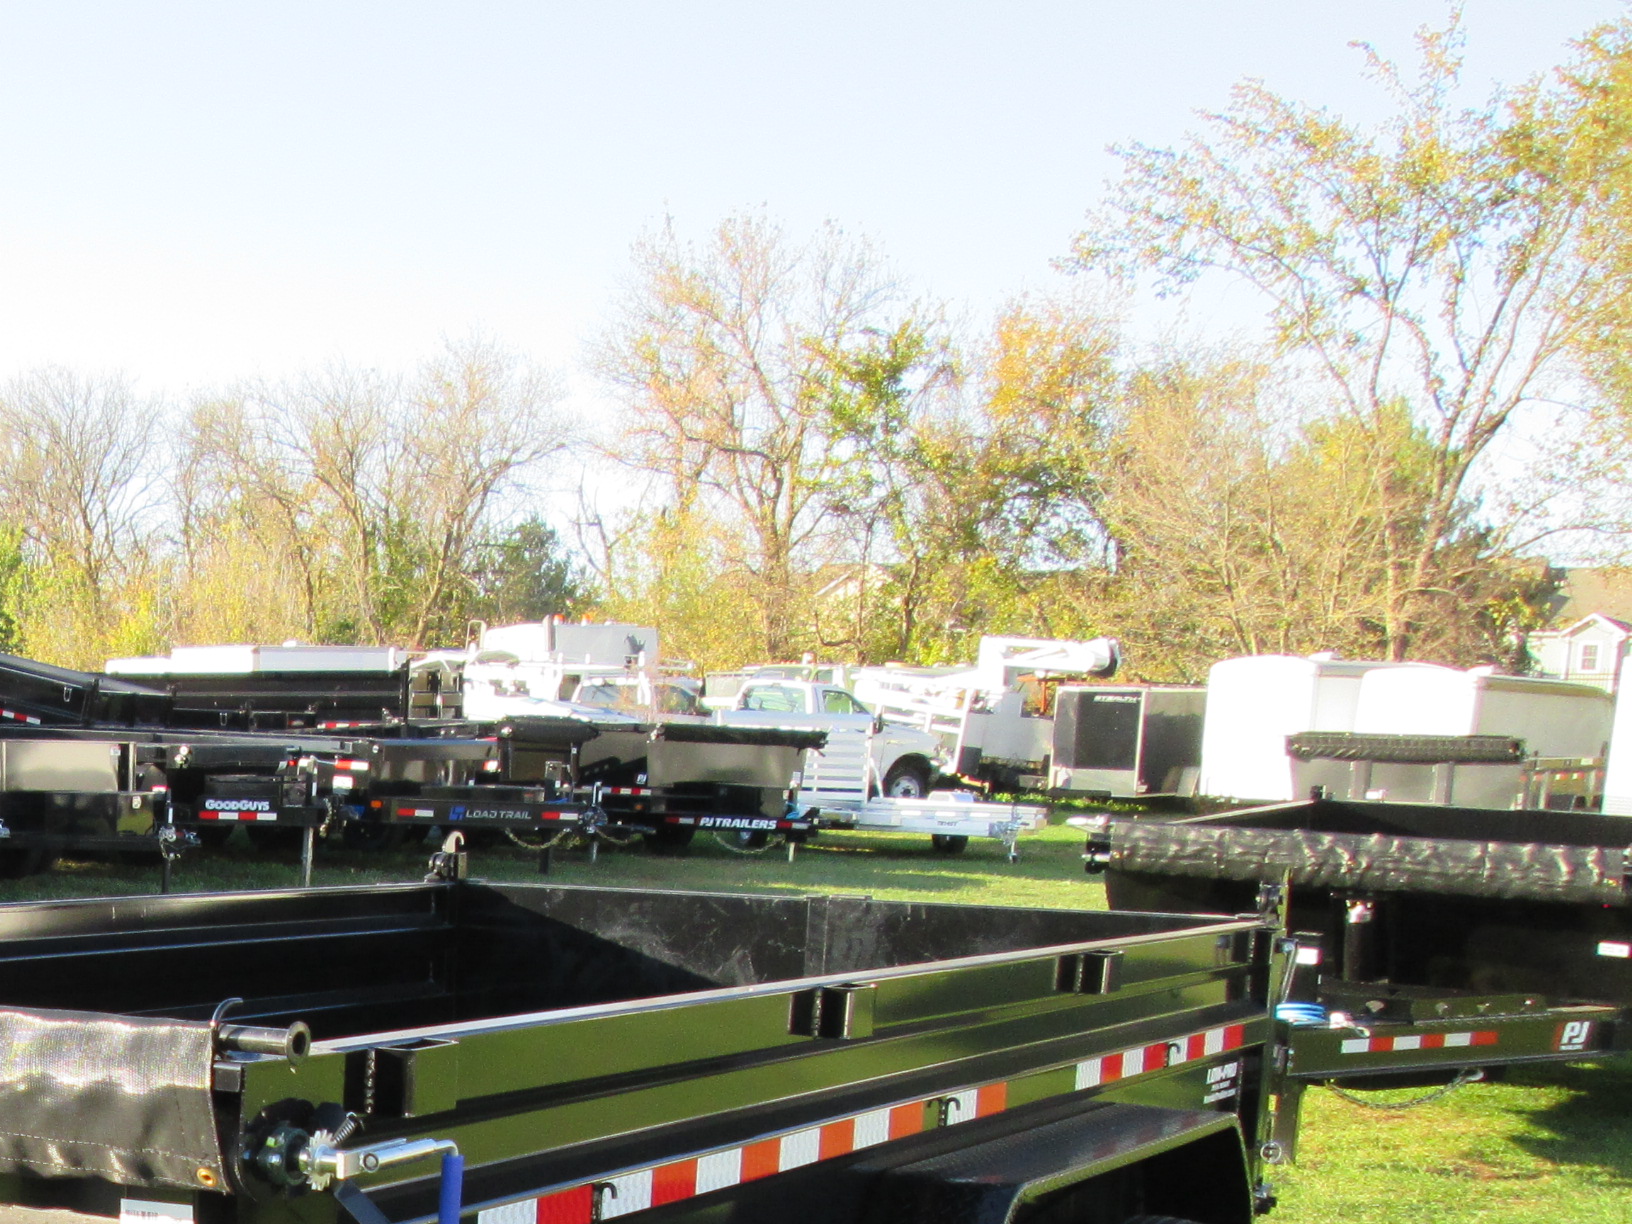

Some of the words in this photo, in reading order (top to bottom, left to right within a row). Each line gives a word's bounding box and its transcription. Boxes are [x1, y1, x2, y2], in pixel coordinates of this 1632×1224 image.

[465, 809, 498, 819] LOAD
[499, 810, 532, 820] TRAIL
[699, 817, 715, 827] PJ
[715, 817, 777, 830] TRAILERS
[1561, 1021, 1590, 1044] PJ
